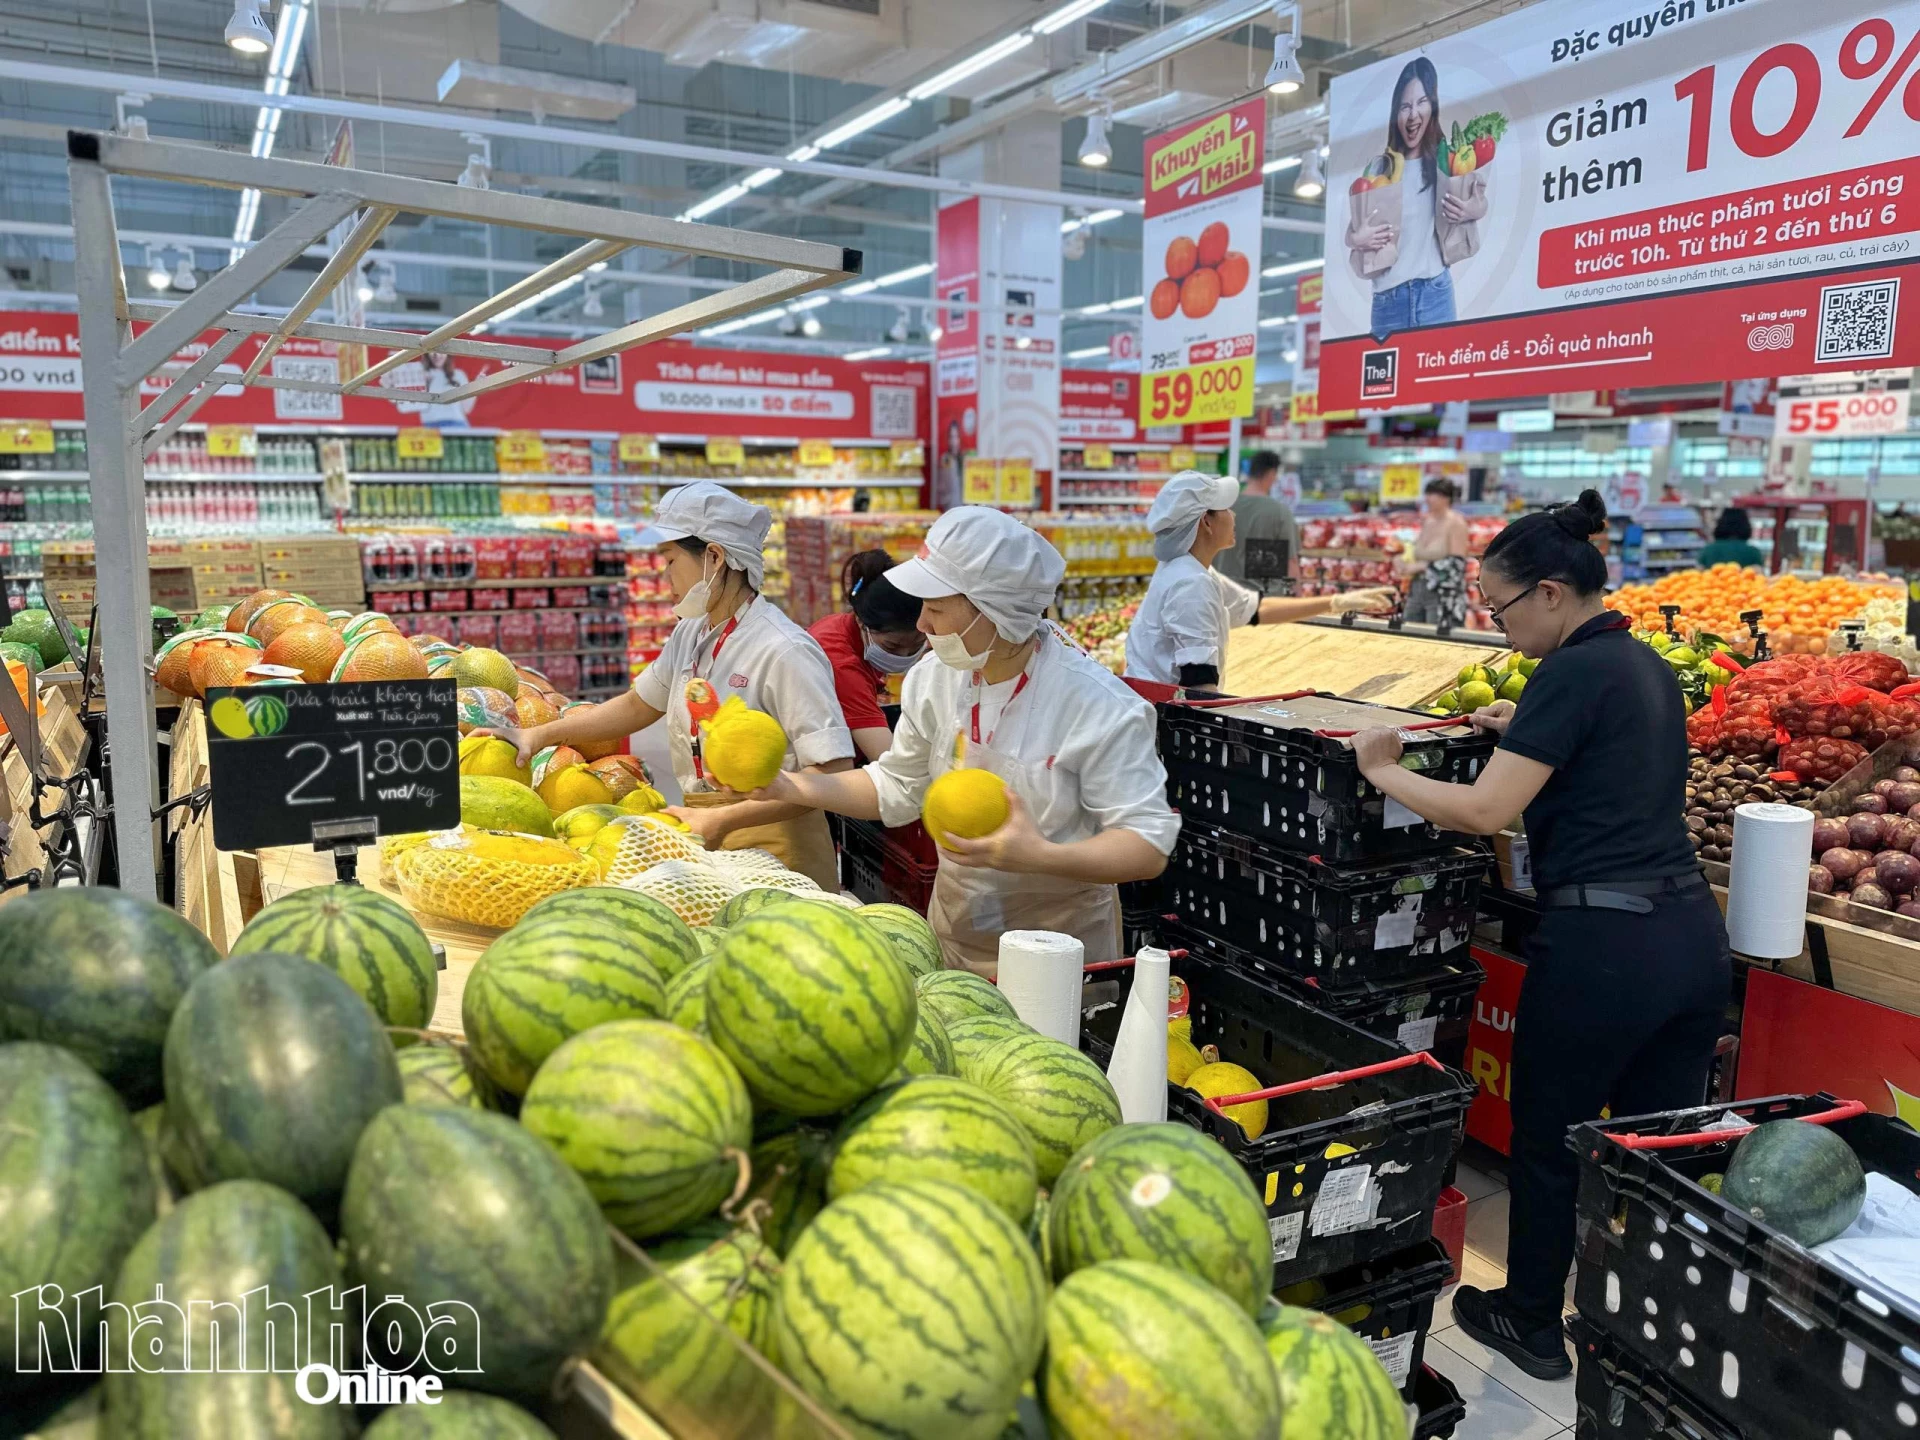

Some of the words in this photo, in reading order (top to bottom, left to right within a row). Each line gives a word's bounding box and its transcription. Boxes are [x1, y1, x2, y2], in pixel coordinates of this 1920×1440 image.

[1550, 29, 1600, 62] Đặc
[1674, 18, 1920, 173] 10%
[1546, 97, 1648, 148] Giảm
[1154, 125, 1225, 181] Khuyến
[1542, 156, 1642, 202] thêm
[1574, 226, 1604, 250] Khi
[1610, 221, 1651, 244] mua
[1658, 209, 1704, 236] thực
[1710, 196, 1775, 228] phẩm
[1782, 183, 1832, 212] tươi
[1839, 173, 1905, 204] sống
[1574, 249, 1624, 275] trước
[1631, 240, 1671, 267] 10h.
[1678, 231, 1704, 259] Từ
[1709, 226, 1748, 252] thứ
[1753, 225, 1768, 247] 2
[1774, 215, 1821, 243] đến
[1829, 206, 1873, 234] thứ
[1879, 203, 1898, 225] 6
[1582, 285, 1604, 298] dụng
[1606, 283, 1622, 293] cho
[1624, 281, 1645, 291] toàn
[1647, 278, 1659, 288] bộ
[1661, 275, 1678, 285] sản
[1679, 269, 1707, 284] phẩm
[1748, 260, 1764, 272] hải
[1767, 257, 1786, 269] sản
[1815, 253, 1836, 263] rau,
[1859, 244, 1879, 256] trái
[1882, 239, 1910, 253] cây)
[1740, 313, 1756, 323] Tại
[1757, 310, 1777, 322] ứng
[1780, 308, 1808, 319] dụng
[1747, 323, 1795, 352] GO!
[1416, 351, 1446, 370] Tích
[1449, 343, 1486, 366] điểm
[1489, 340, 1510, 362] dễ
[1525, 333, 1554, 358] Đổi
[1558, 333, 1591, 357] quà
[1596, 326, 1654, 351] nhanh
[33, 368, 76, 384] vnd
[657, 361, 695, 380] Tích
[739, 365, 763, 383] khi
[765, 372, 800, 385] mua
[1151, 365, 1243, 421] 59.000
[1788, 396, 1898, 434] 55.000
[375, 685, 422, 709] không
[426, 684, 458, 706] hạt
[285, 737, 453, 805] 21.800
